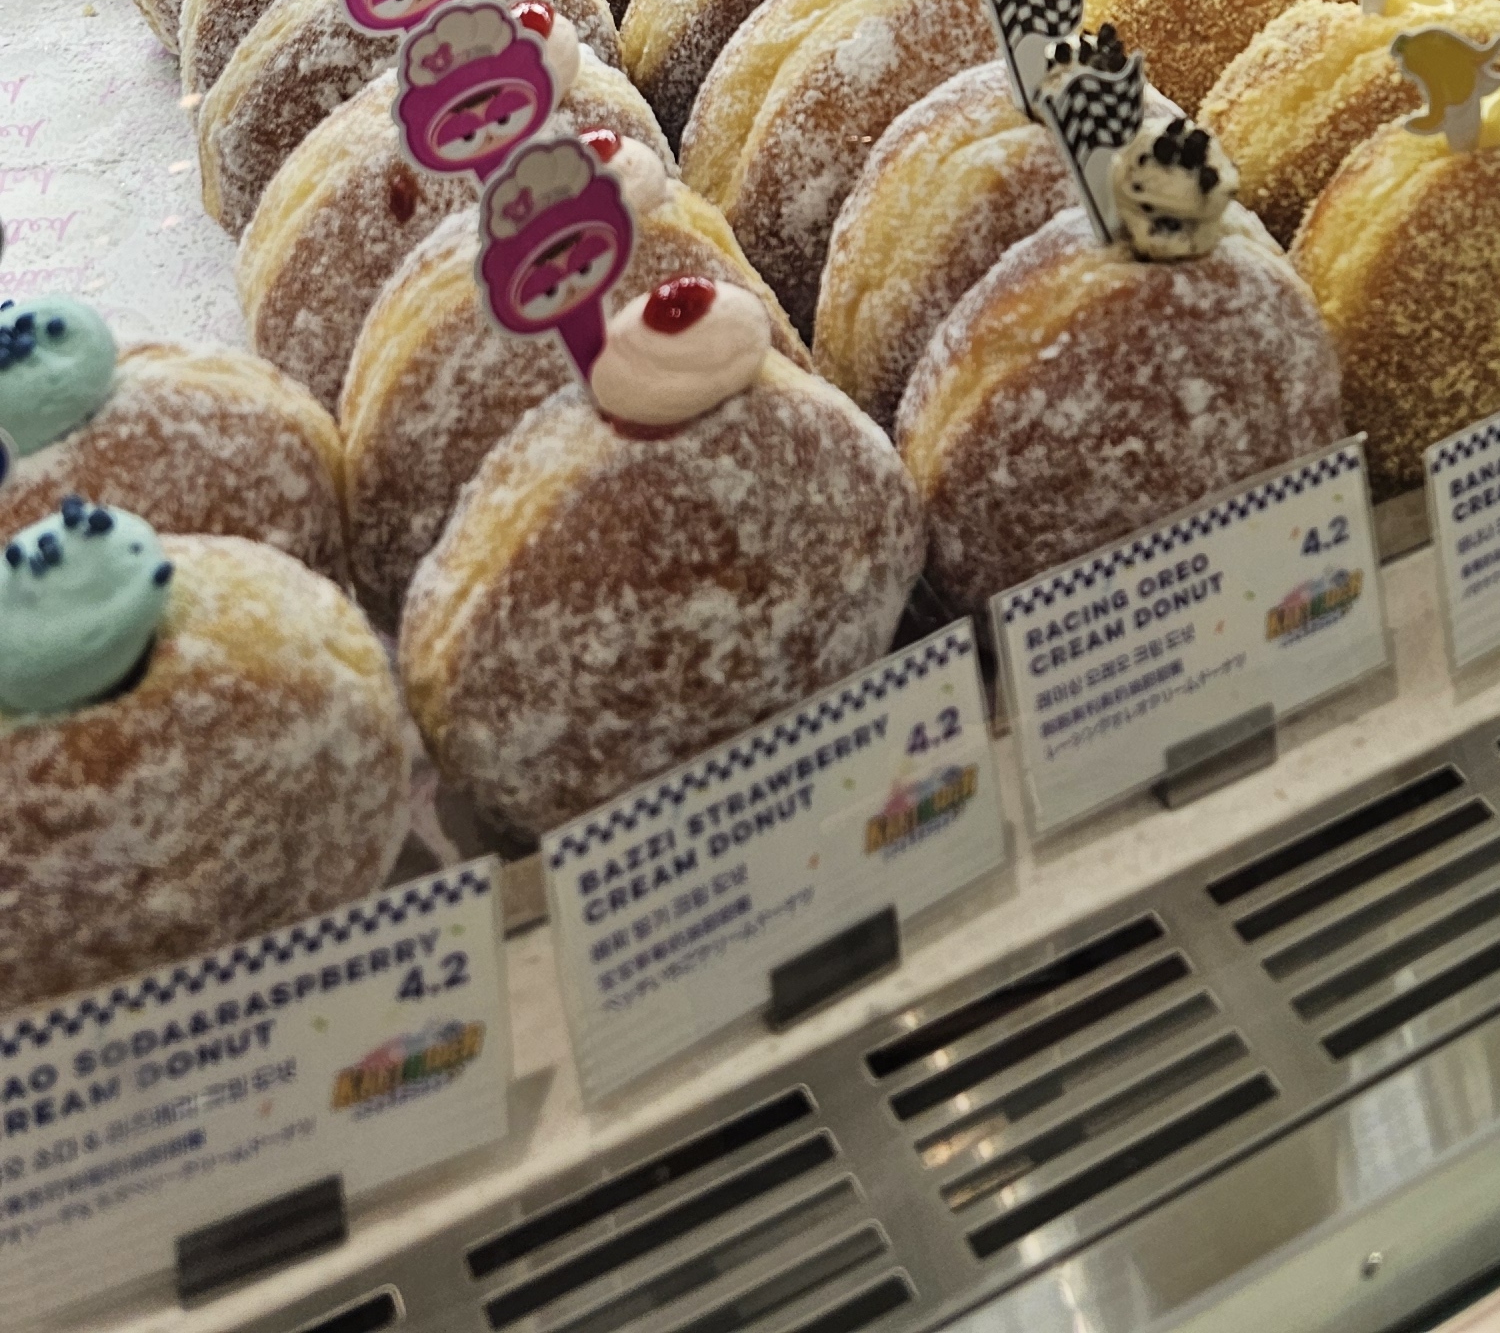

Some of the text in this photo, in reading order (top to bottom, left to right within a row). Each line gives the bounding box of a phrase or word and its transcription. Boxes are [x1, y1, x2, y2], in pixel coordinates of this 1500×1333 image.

[1301, 514, 1351, 558] 4.2
[1024, 551, 1211, 652] RACING OREO
[1028, 571, 1225, 678] CREAM DONUT
[905, 705, 964, 756] 4.2
[577, 713, 891, 895] BAZZI STRAWBERRY
[582, 785, 818, 926] CREAM DONUT
[398, 949, 472, 1002] 4.2
[133, 1017, 278, 1092] DONUT
